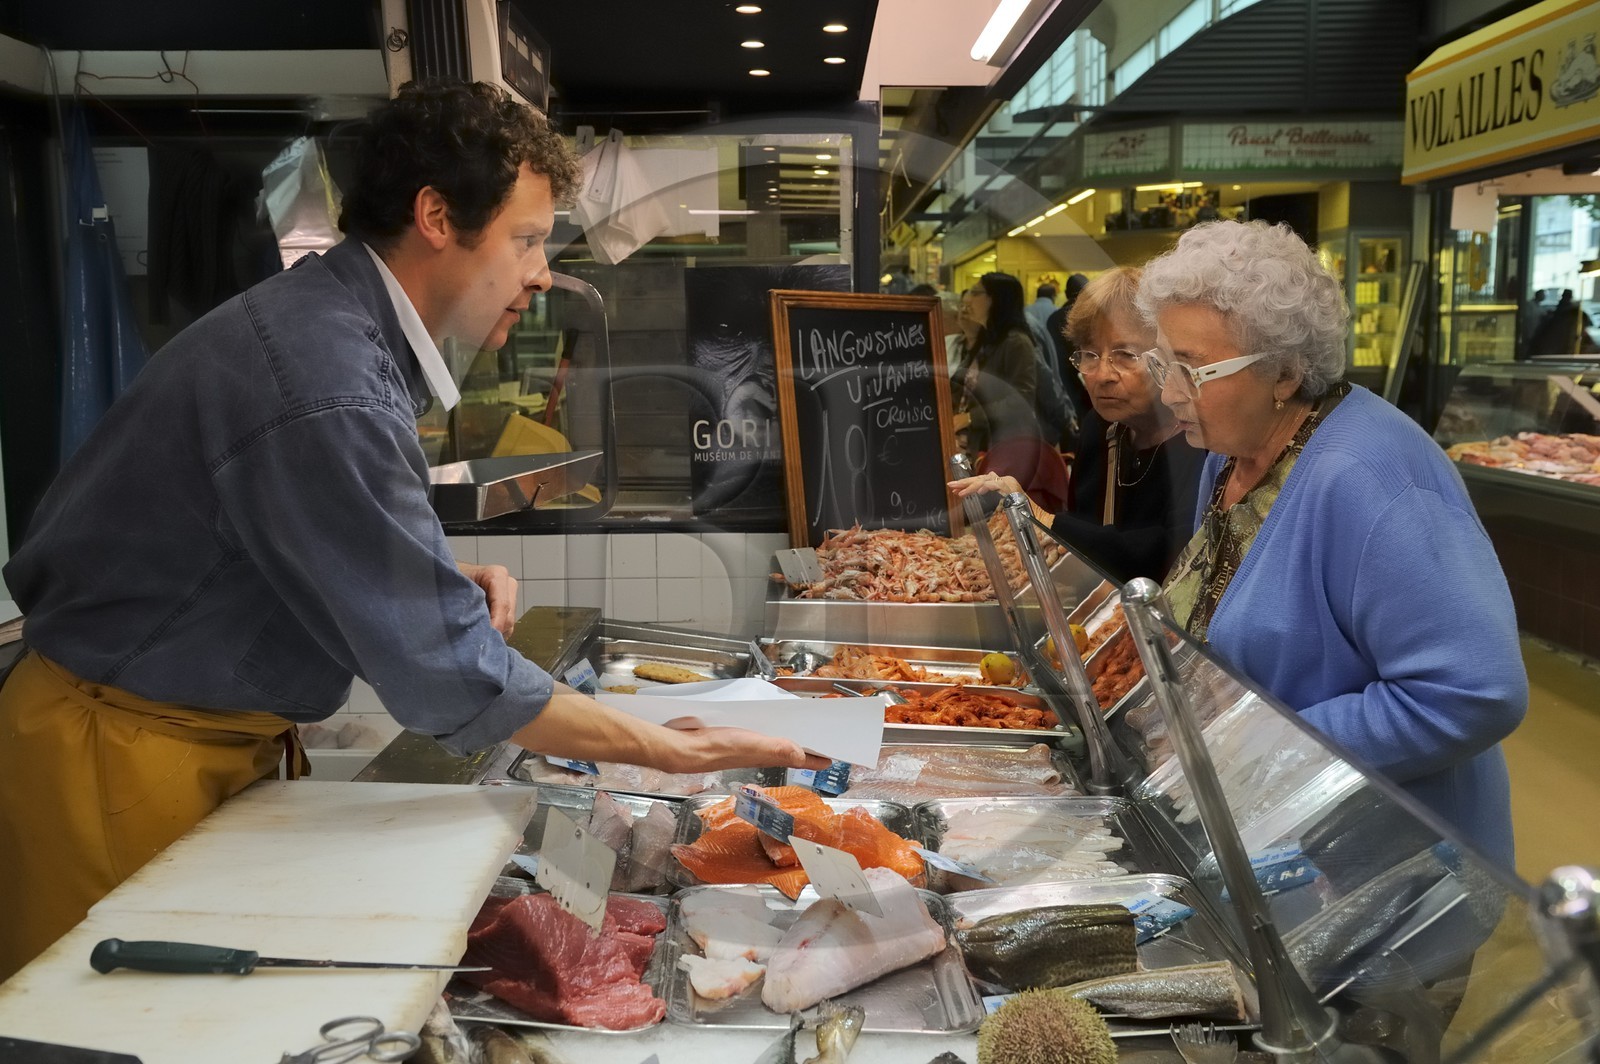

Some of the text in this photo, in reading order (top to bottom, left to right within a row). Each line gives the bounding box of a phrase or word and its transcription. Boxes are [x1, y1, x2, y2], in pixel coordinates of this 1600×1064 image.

[1410, 49, 1545, 153] VOLAILLES
[798, 322, 926, 380] LANGOUSTINES
[692, 419, 771, 450] GORI
[694, 449, 736, 462] MUSÉUM
[739, 450, 753, 461] DE
